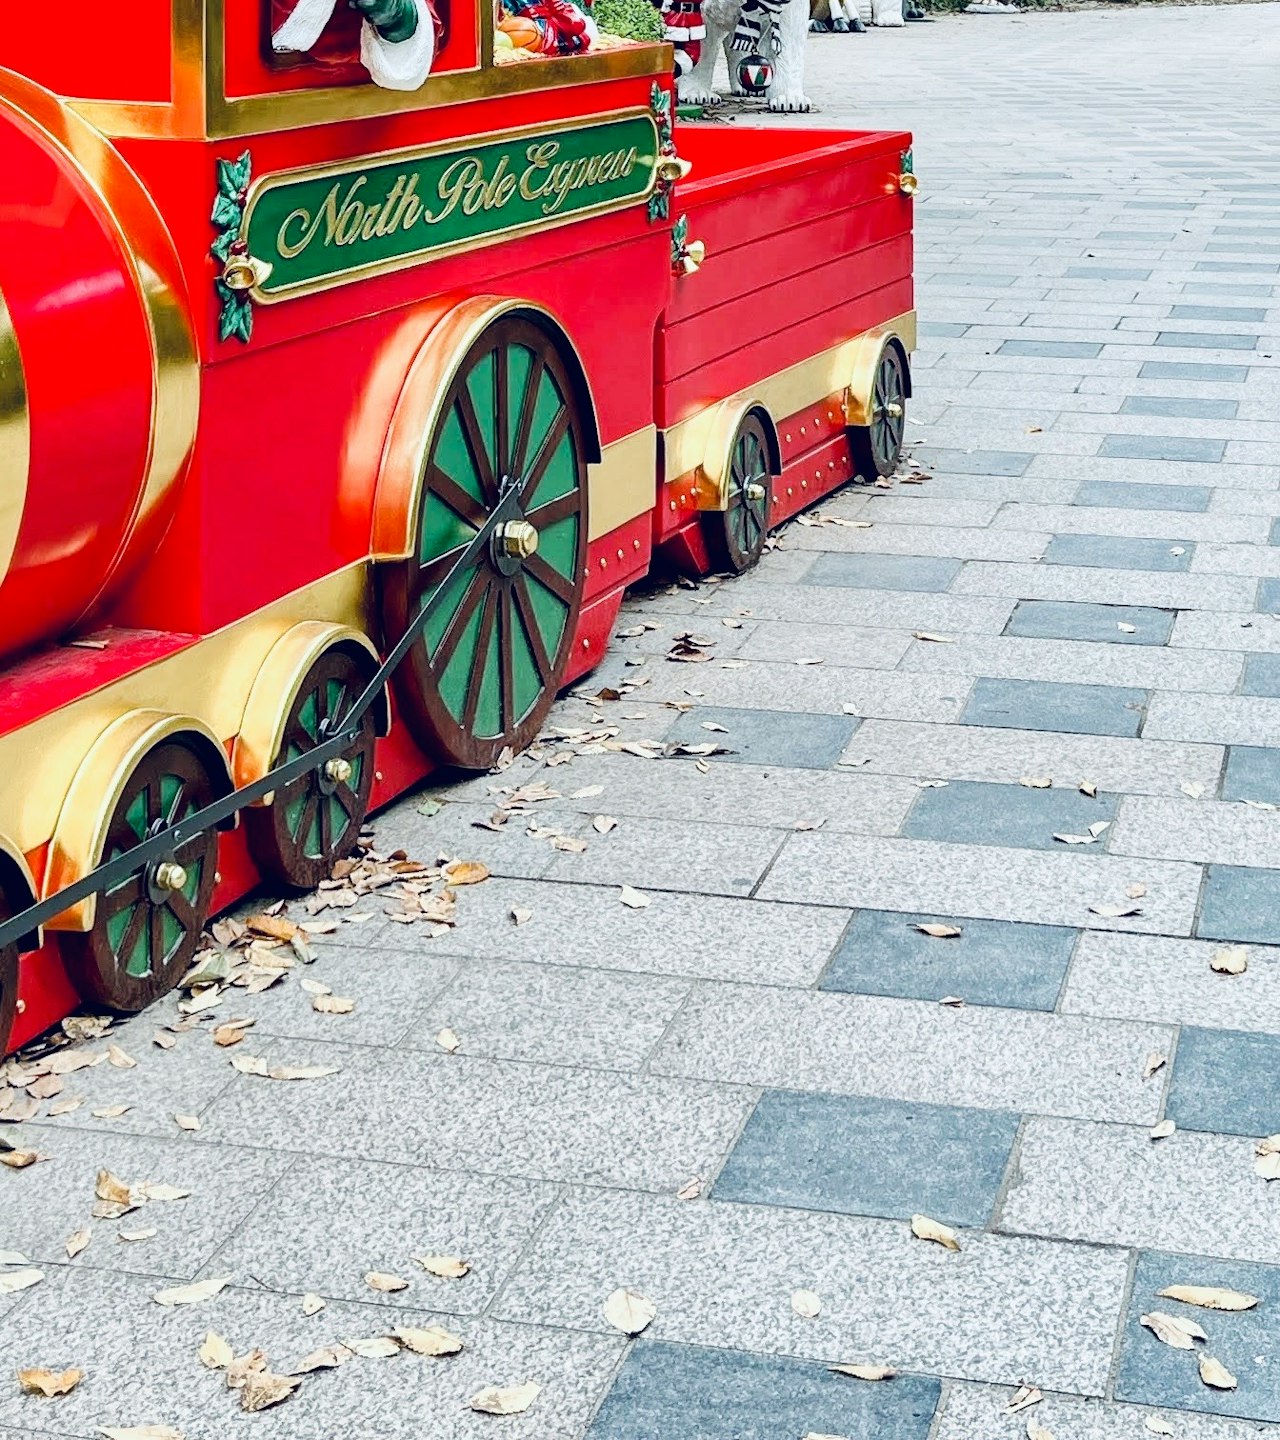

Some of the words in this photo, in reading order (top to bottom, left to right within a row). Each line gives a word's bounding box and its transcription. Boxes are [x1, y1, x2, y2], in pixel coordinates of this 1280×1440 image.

[276, 173, 424, 258] North
[424, 155, 517, 223] Pole
[520, 140, 638, 215] Express
